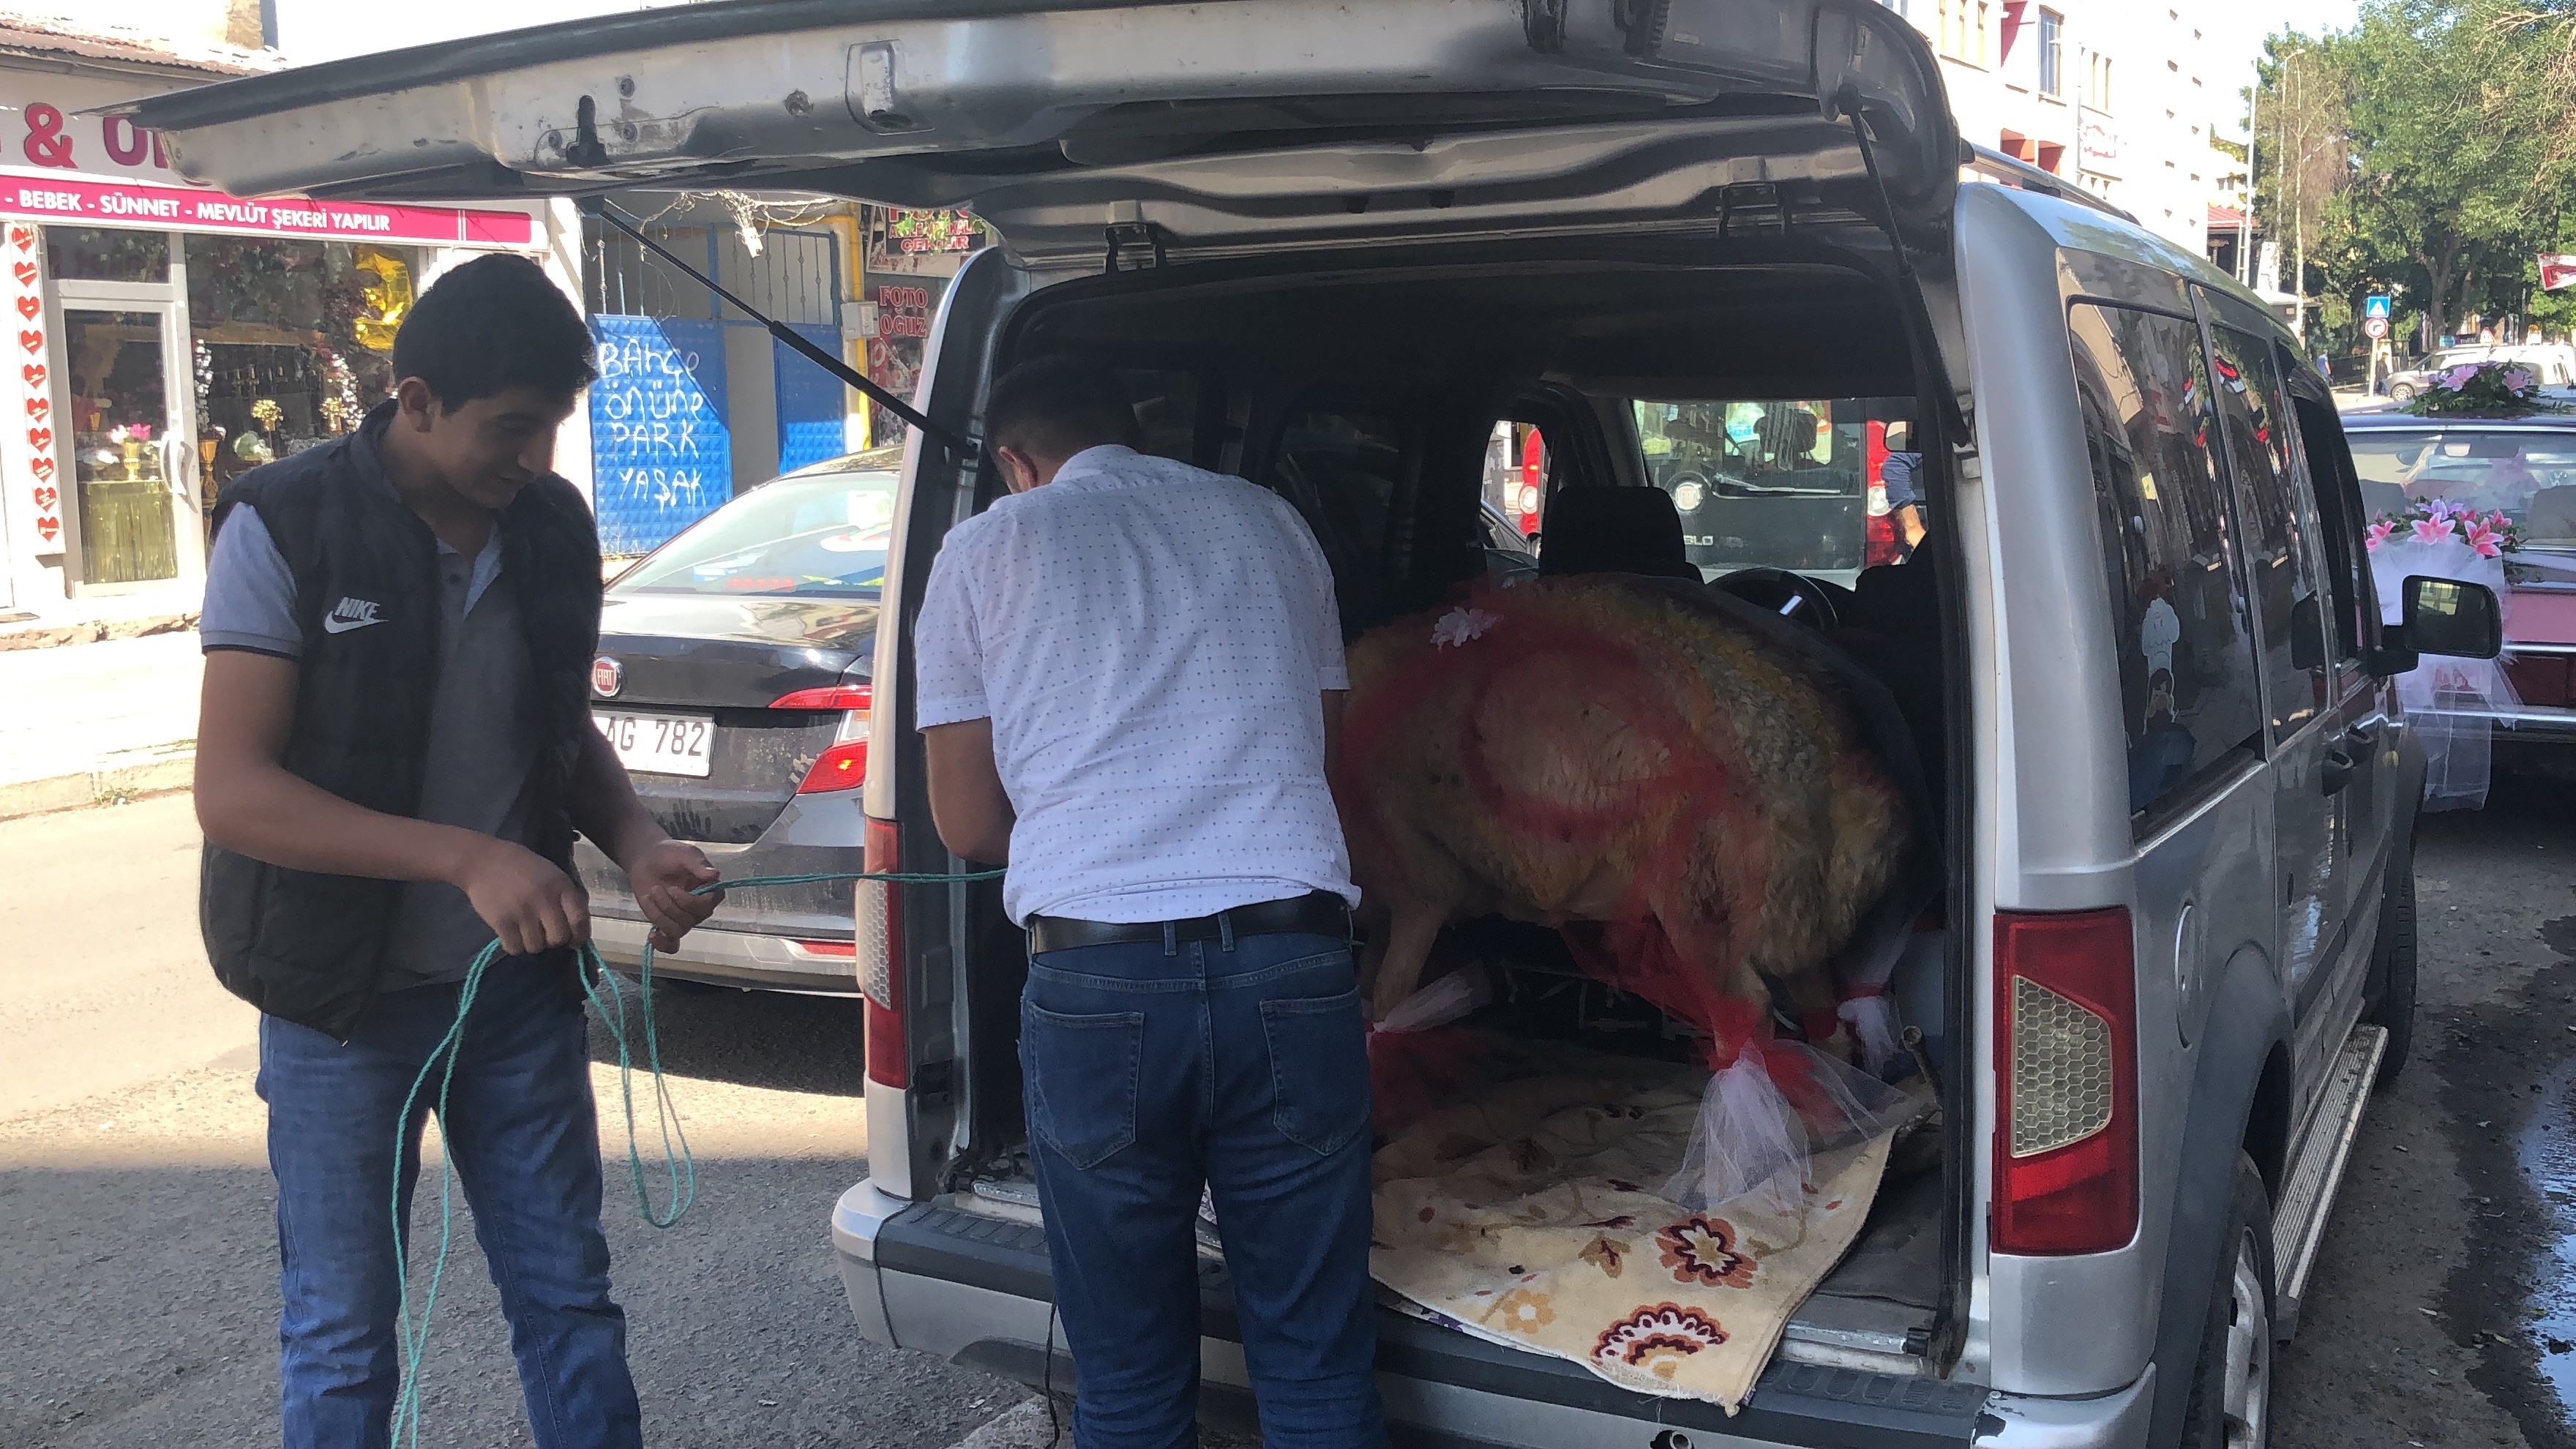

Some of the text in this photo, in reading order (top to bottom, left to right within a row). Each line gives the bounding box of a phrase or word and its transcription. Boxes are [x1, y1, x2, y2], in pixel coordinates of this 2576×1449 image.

[19, 189, 83, 211] BEBEK
[100, 192, 181, 217] SÜNNET
[197, 201, 268, 224] MEVLÜT
[272, 208, 328, 230] ŞEKERİ
[330, 212, 391, 231] YAPILIR
[879, 285, 929, 309] FOTO
[880, 307, 927, 338] OĞUZ
[612, 418, 699, 463] PARK
[335, 596, 381, 621] NIKE
[597, 668, 613, 686] FIAT
[655, 719, 705, 756] 782
